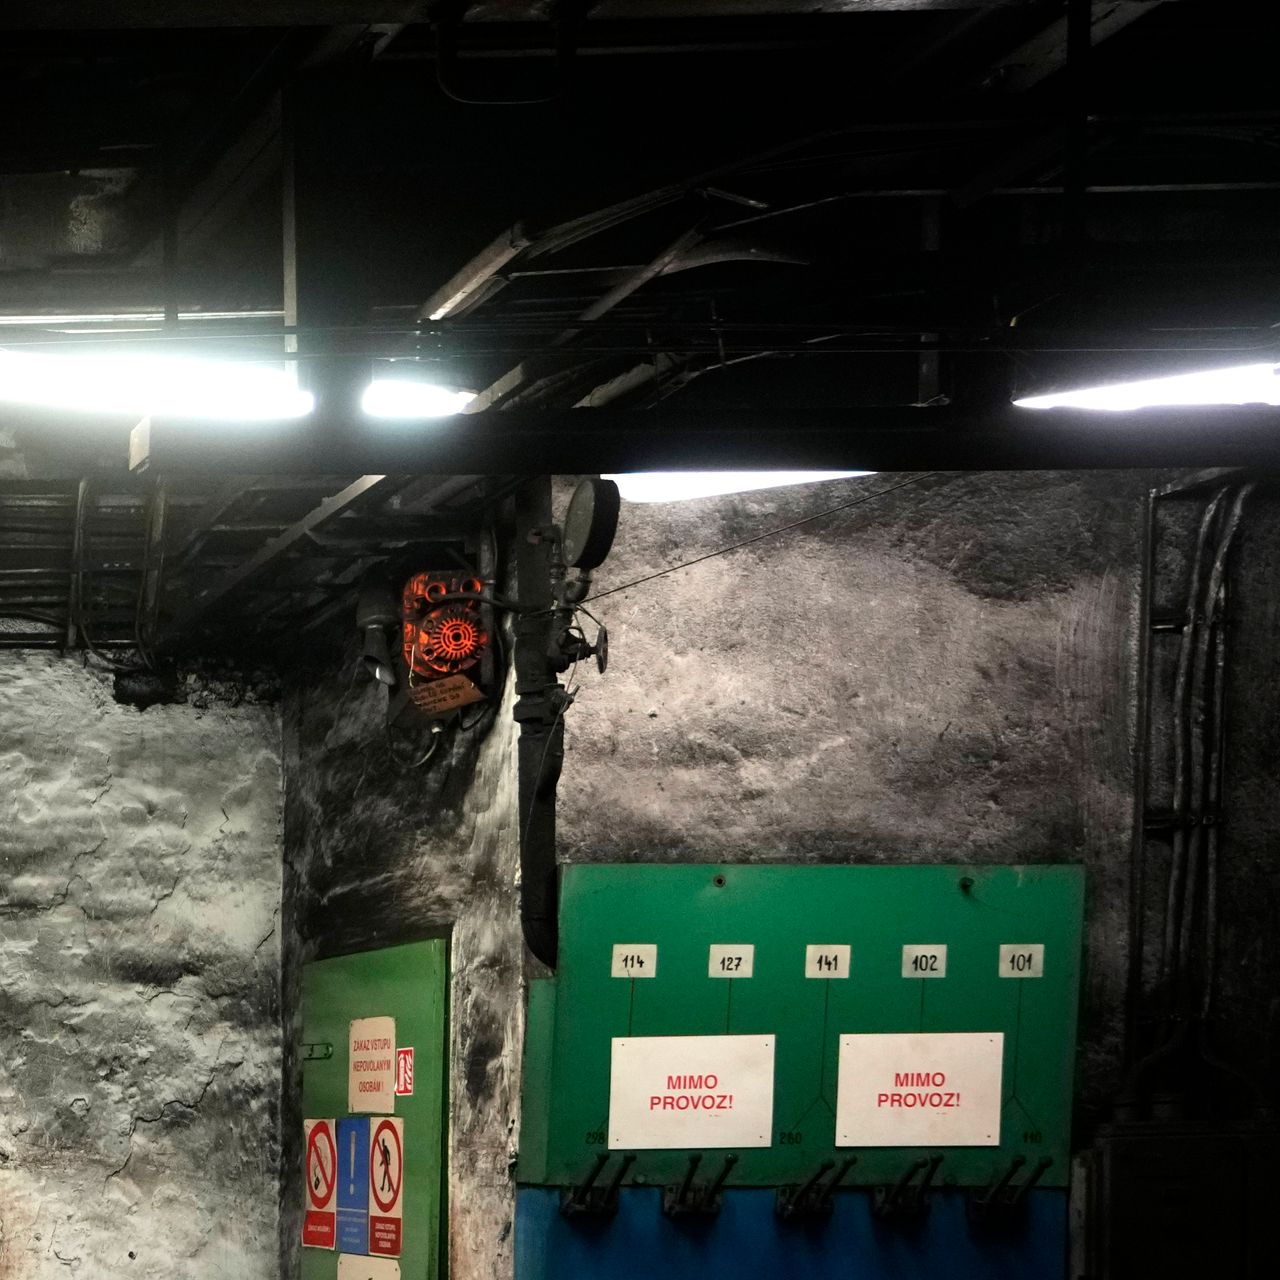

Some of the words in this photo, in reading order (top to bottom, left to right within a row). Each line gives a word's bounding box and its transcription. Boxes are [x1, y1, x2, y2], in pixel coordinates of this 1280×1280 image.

[622, 954, 645, 968] 114
[719, 956, 743, 971] 127
[816, 954, 839, 971] 141
[911, 954, 938, 972] 102
[1009, 953, 1033, 972] 101
[667, 1074, 718, 1090] MIMO
[894, 1072, 945, 1087] MIMO
[650, 1095, 733, 1110] PROVOZ!
[878, 1093, 960, 1108] PROVOZ!
